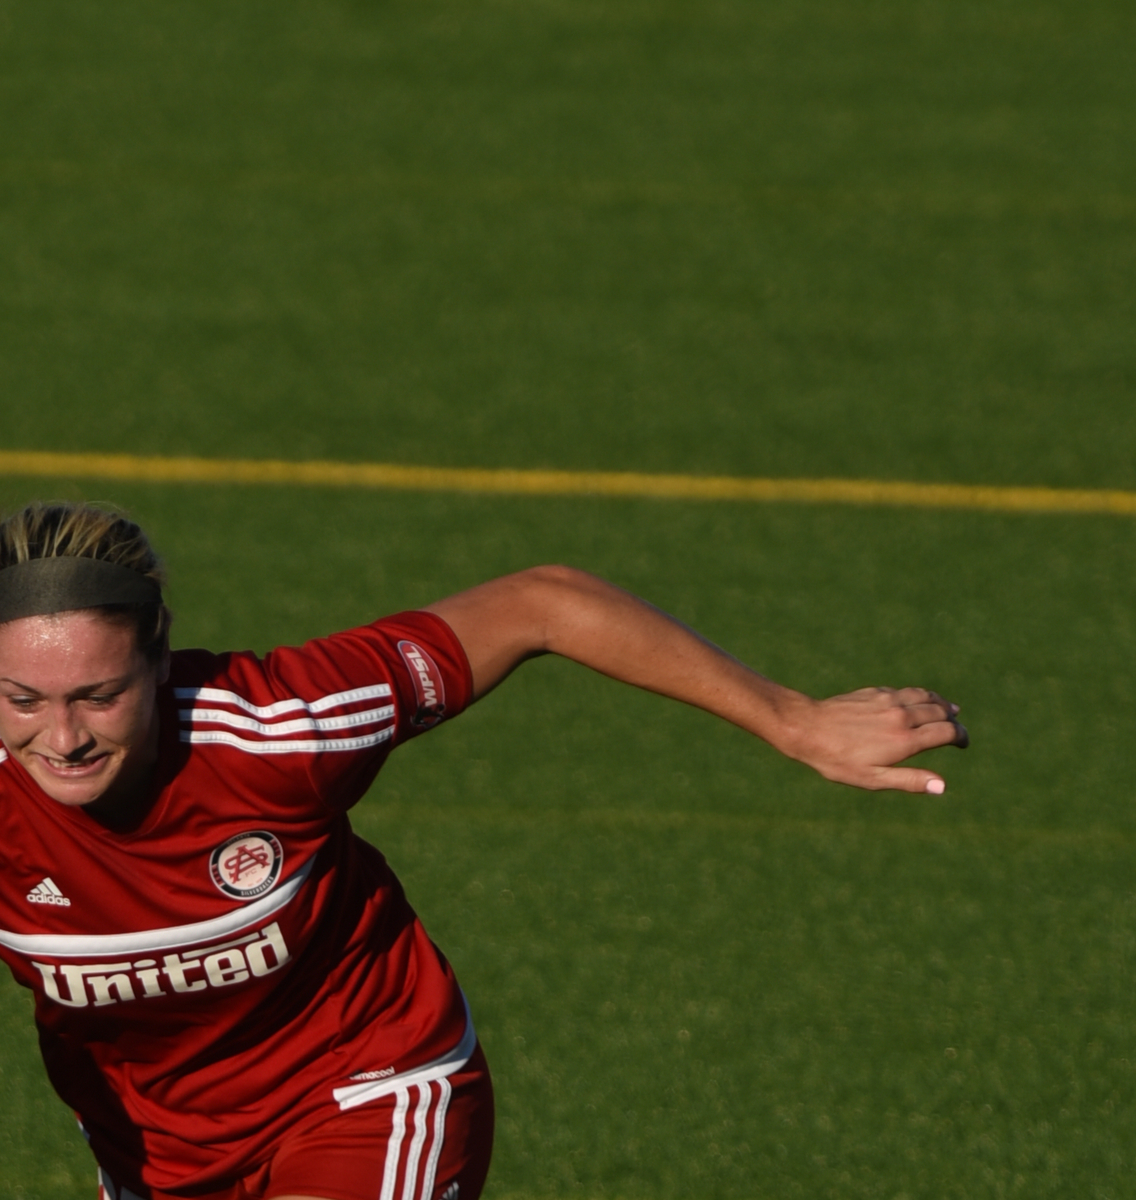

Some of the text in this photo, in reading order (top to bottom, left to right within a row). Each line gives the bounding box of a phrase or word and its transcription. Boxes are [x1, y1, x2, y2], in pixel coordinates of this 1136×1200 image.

[405, 645, 438, 707] WPSL
[26, 892, 72, 908] adidas
[31, 922, 293, 1008] United
